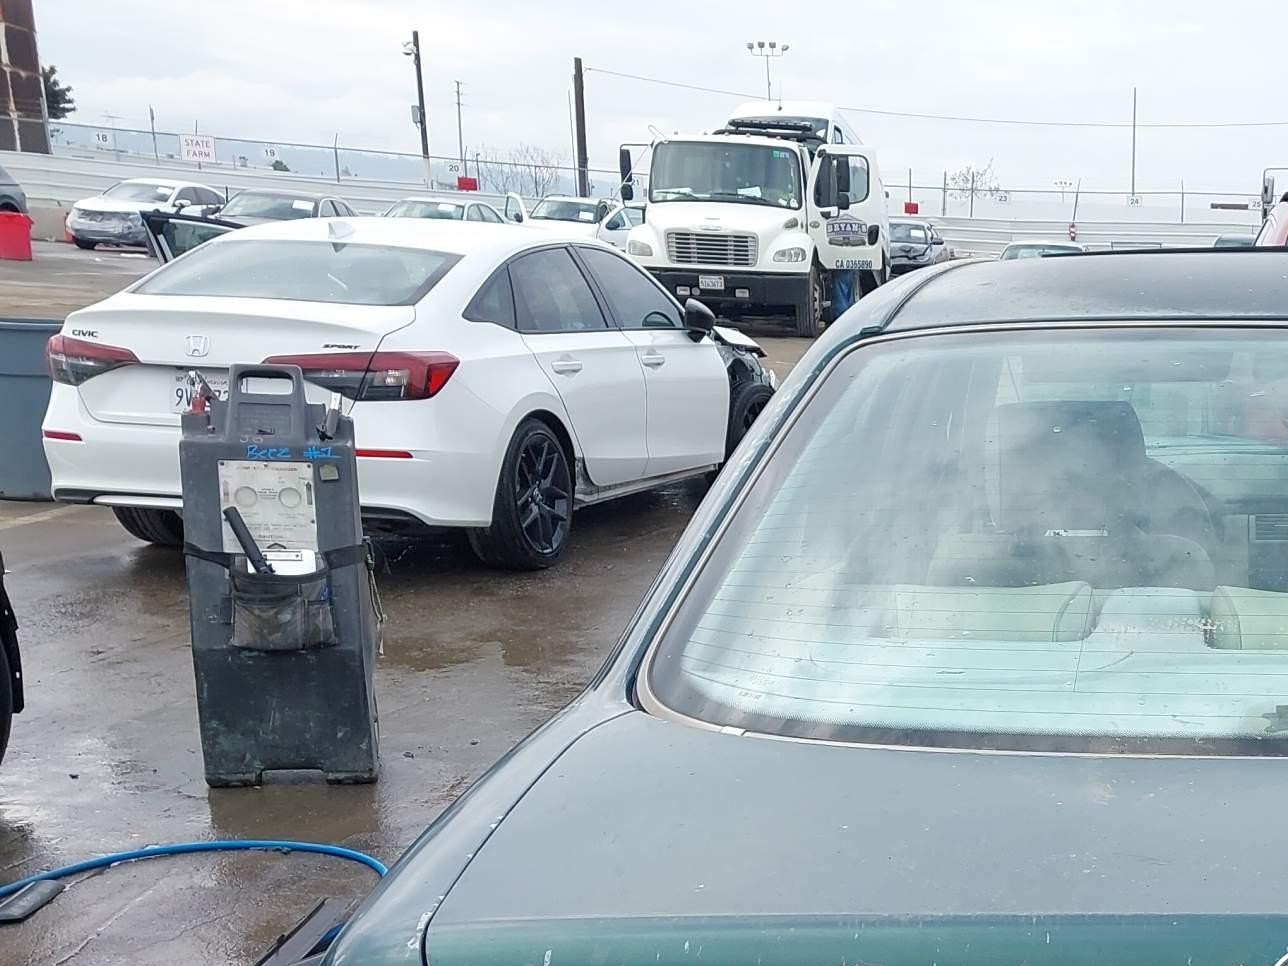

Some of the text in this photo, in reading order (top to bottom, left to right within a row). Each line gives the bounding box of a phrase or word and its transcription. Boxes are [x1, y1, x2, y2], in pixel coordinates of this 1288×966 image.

[95, 133, 108, 142] 18
[184, 138, 210, 148] STATE
[186, 150, 211, 158] FARM
[448, 164, 460, 172] 20
[835, 260, 845, 269] CA
[71, 329, 99, 338] CIVIC
